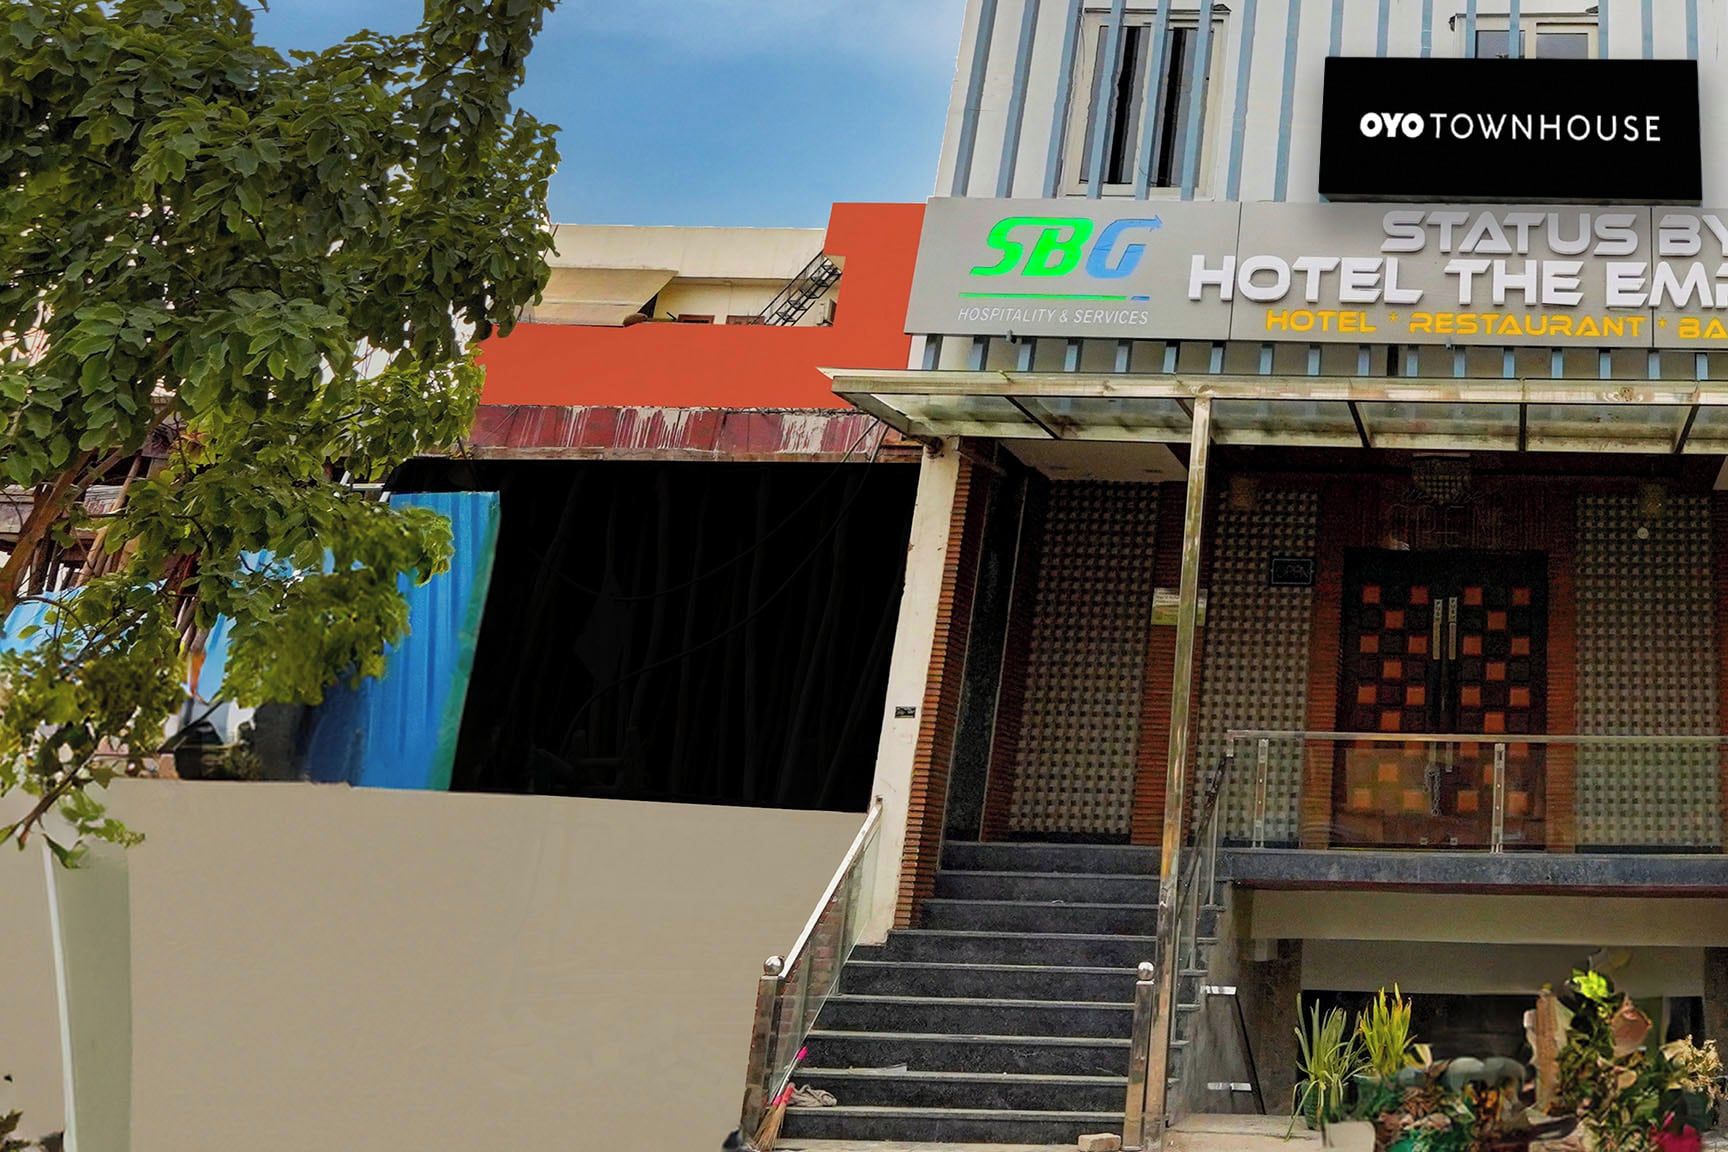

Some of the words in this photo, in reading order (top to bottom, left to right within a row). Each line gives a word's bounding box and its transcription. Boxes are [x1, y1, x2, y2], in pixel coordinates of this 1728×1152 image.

[1359, 111, 1425, 139] OYO
[1429, 112, 1661, 142] TOWNHOUSE
[968, 216, 1163, 279] SBG
[1381, 210, 1640, 256] STATUS
[1187, 254, 1424, 305] HOTEL
[1443, 258, 1585, 307] THE
[957, 307, 1056, 323] HOSPITALITY
[1059, 309, 1070, 324] &
[1073, 309, 1149, 325] SERVICES
[1264, 309, 1378, 334] HOTEL
[1408, 311, 1648, 338] RESTAURANT
